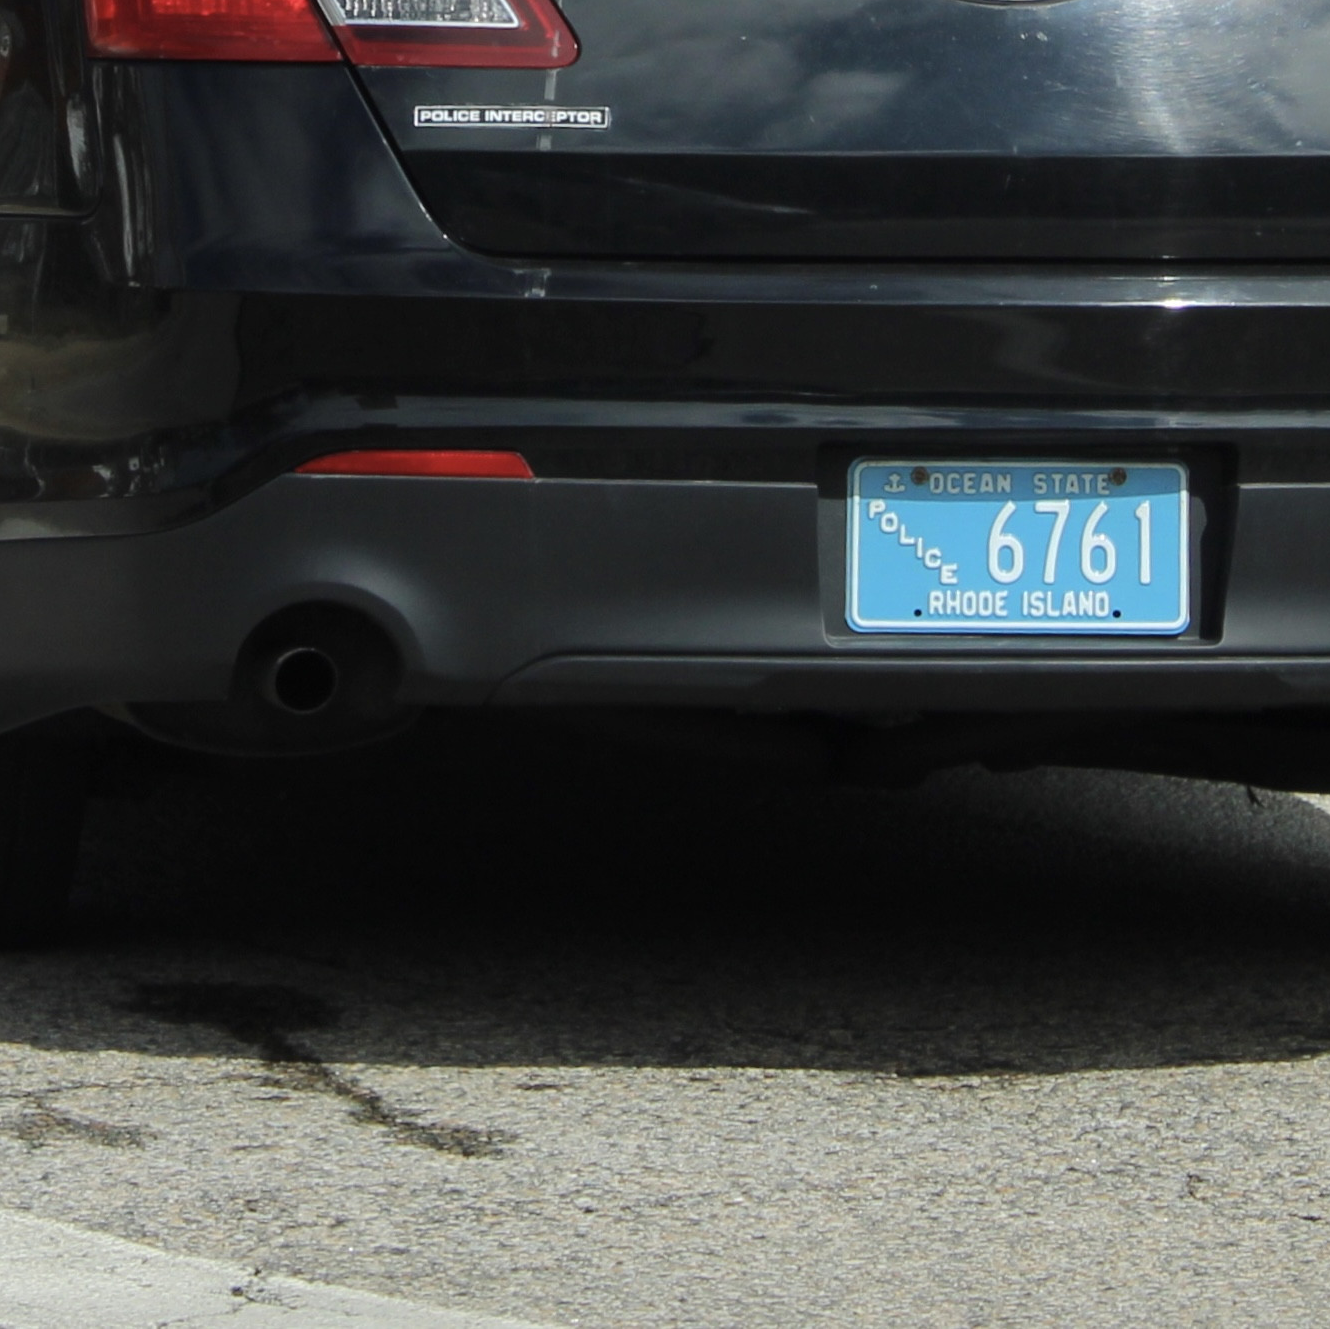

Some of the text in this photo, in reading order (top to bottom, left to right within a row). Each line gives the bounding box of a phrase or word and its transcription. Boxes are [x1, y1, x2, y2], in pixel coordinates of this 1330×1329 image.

[420, 110, 481, 123] POLICE
[929, 472, 1111, 495] OCEAN STATE
[868, 499, 958, 585] POLICE
[987, 499, 1152, 586] 6761
[928, 590, 1111, 618] RHODE ISLAND
